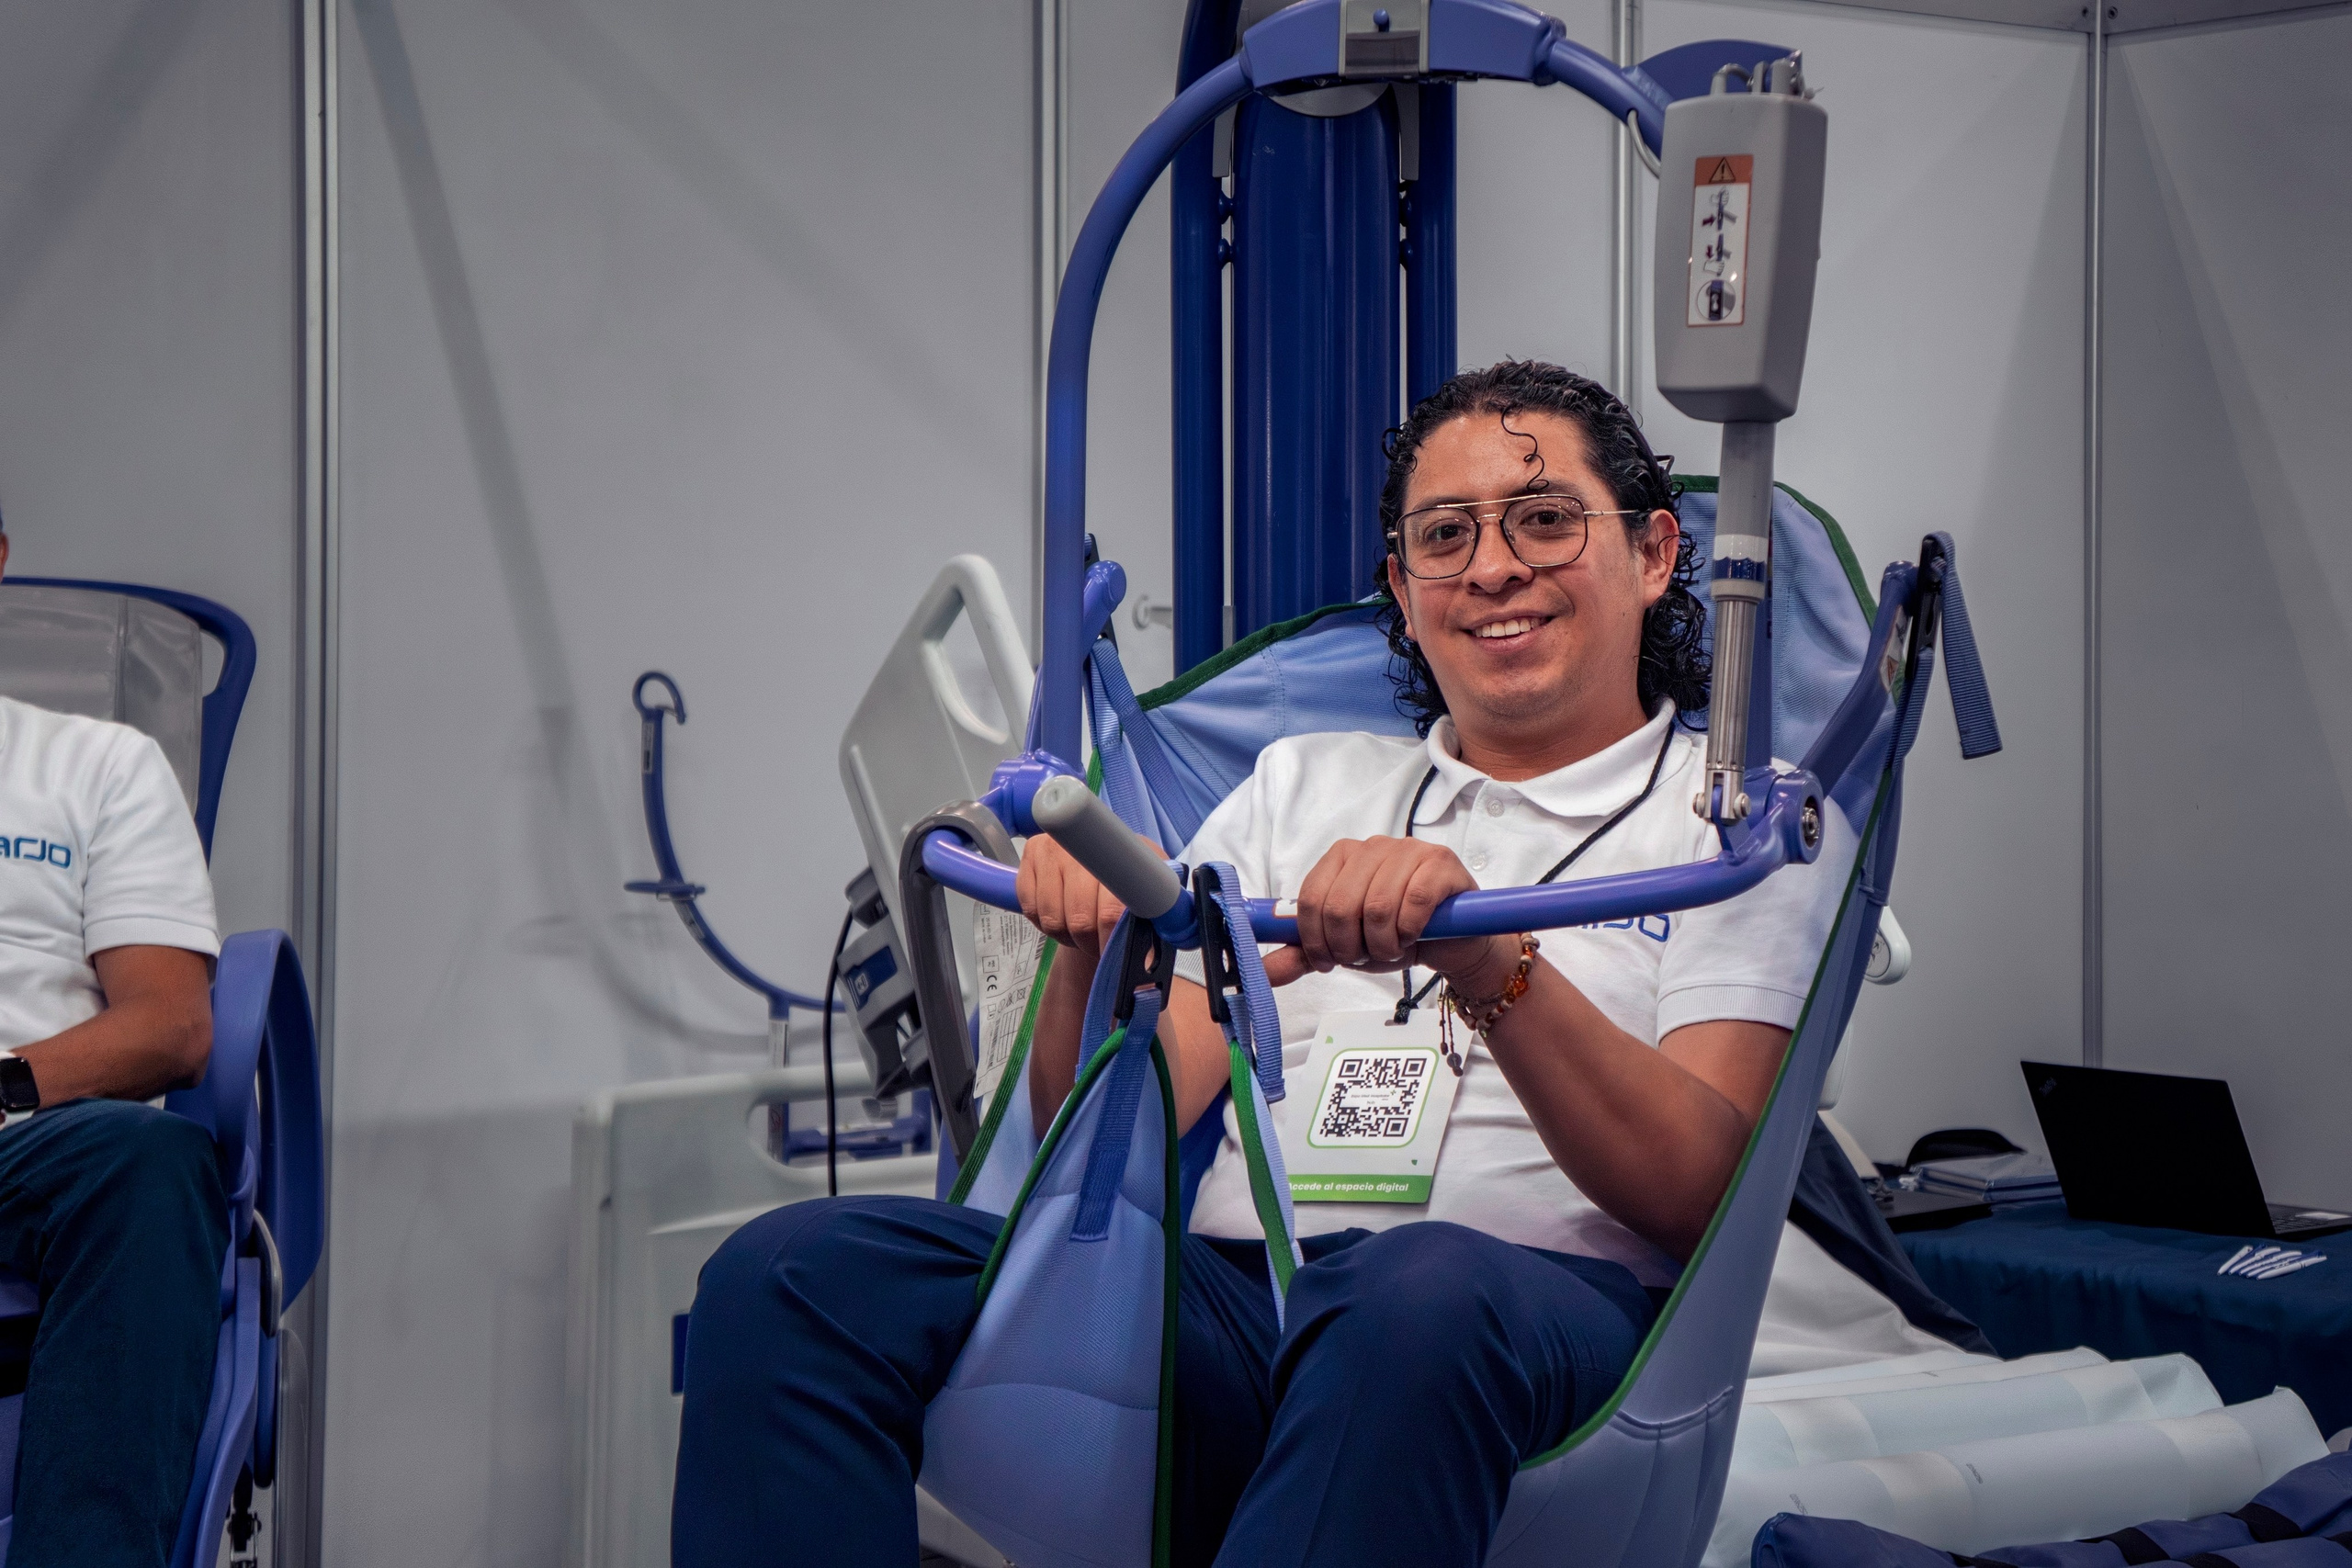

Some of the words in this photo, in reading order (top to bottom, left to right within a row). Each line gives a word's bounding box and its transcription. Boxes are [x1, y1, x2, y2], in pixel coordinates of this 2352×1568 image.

[986, 975, 998, 992] CE
[1324, 1182, 1334, 1190] al
[1335, 1182, 1374, 1192] espacio
[1375, 1182, 1409, 1193] digital
